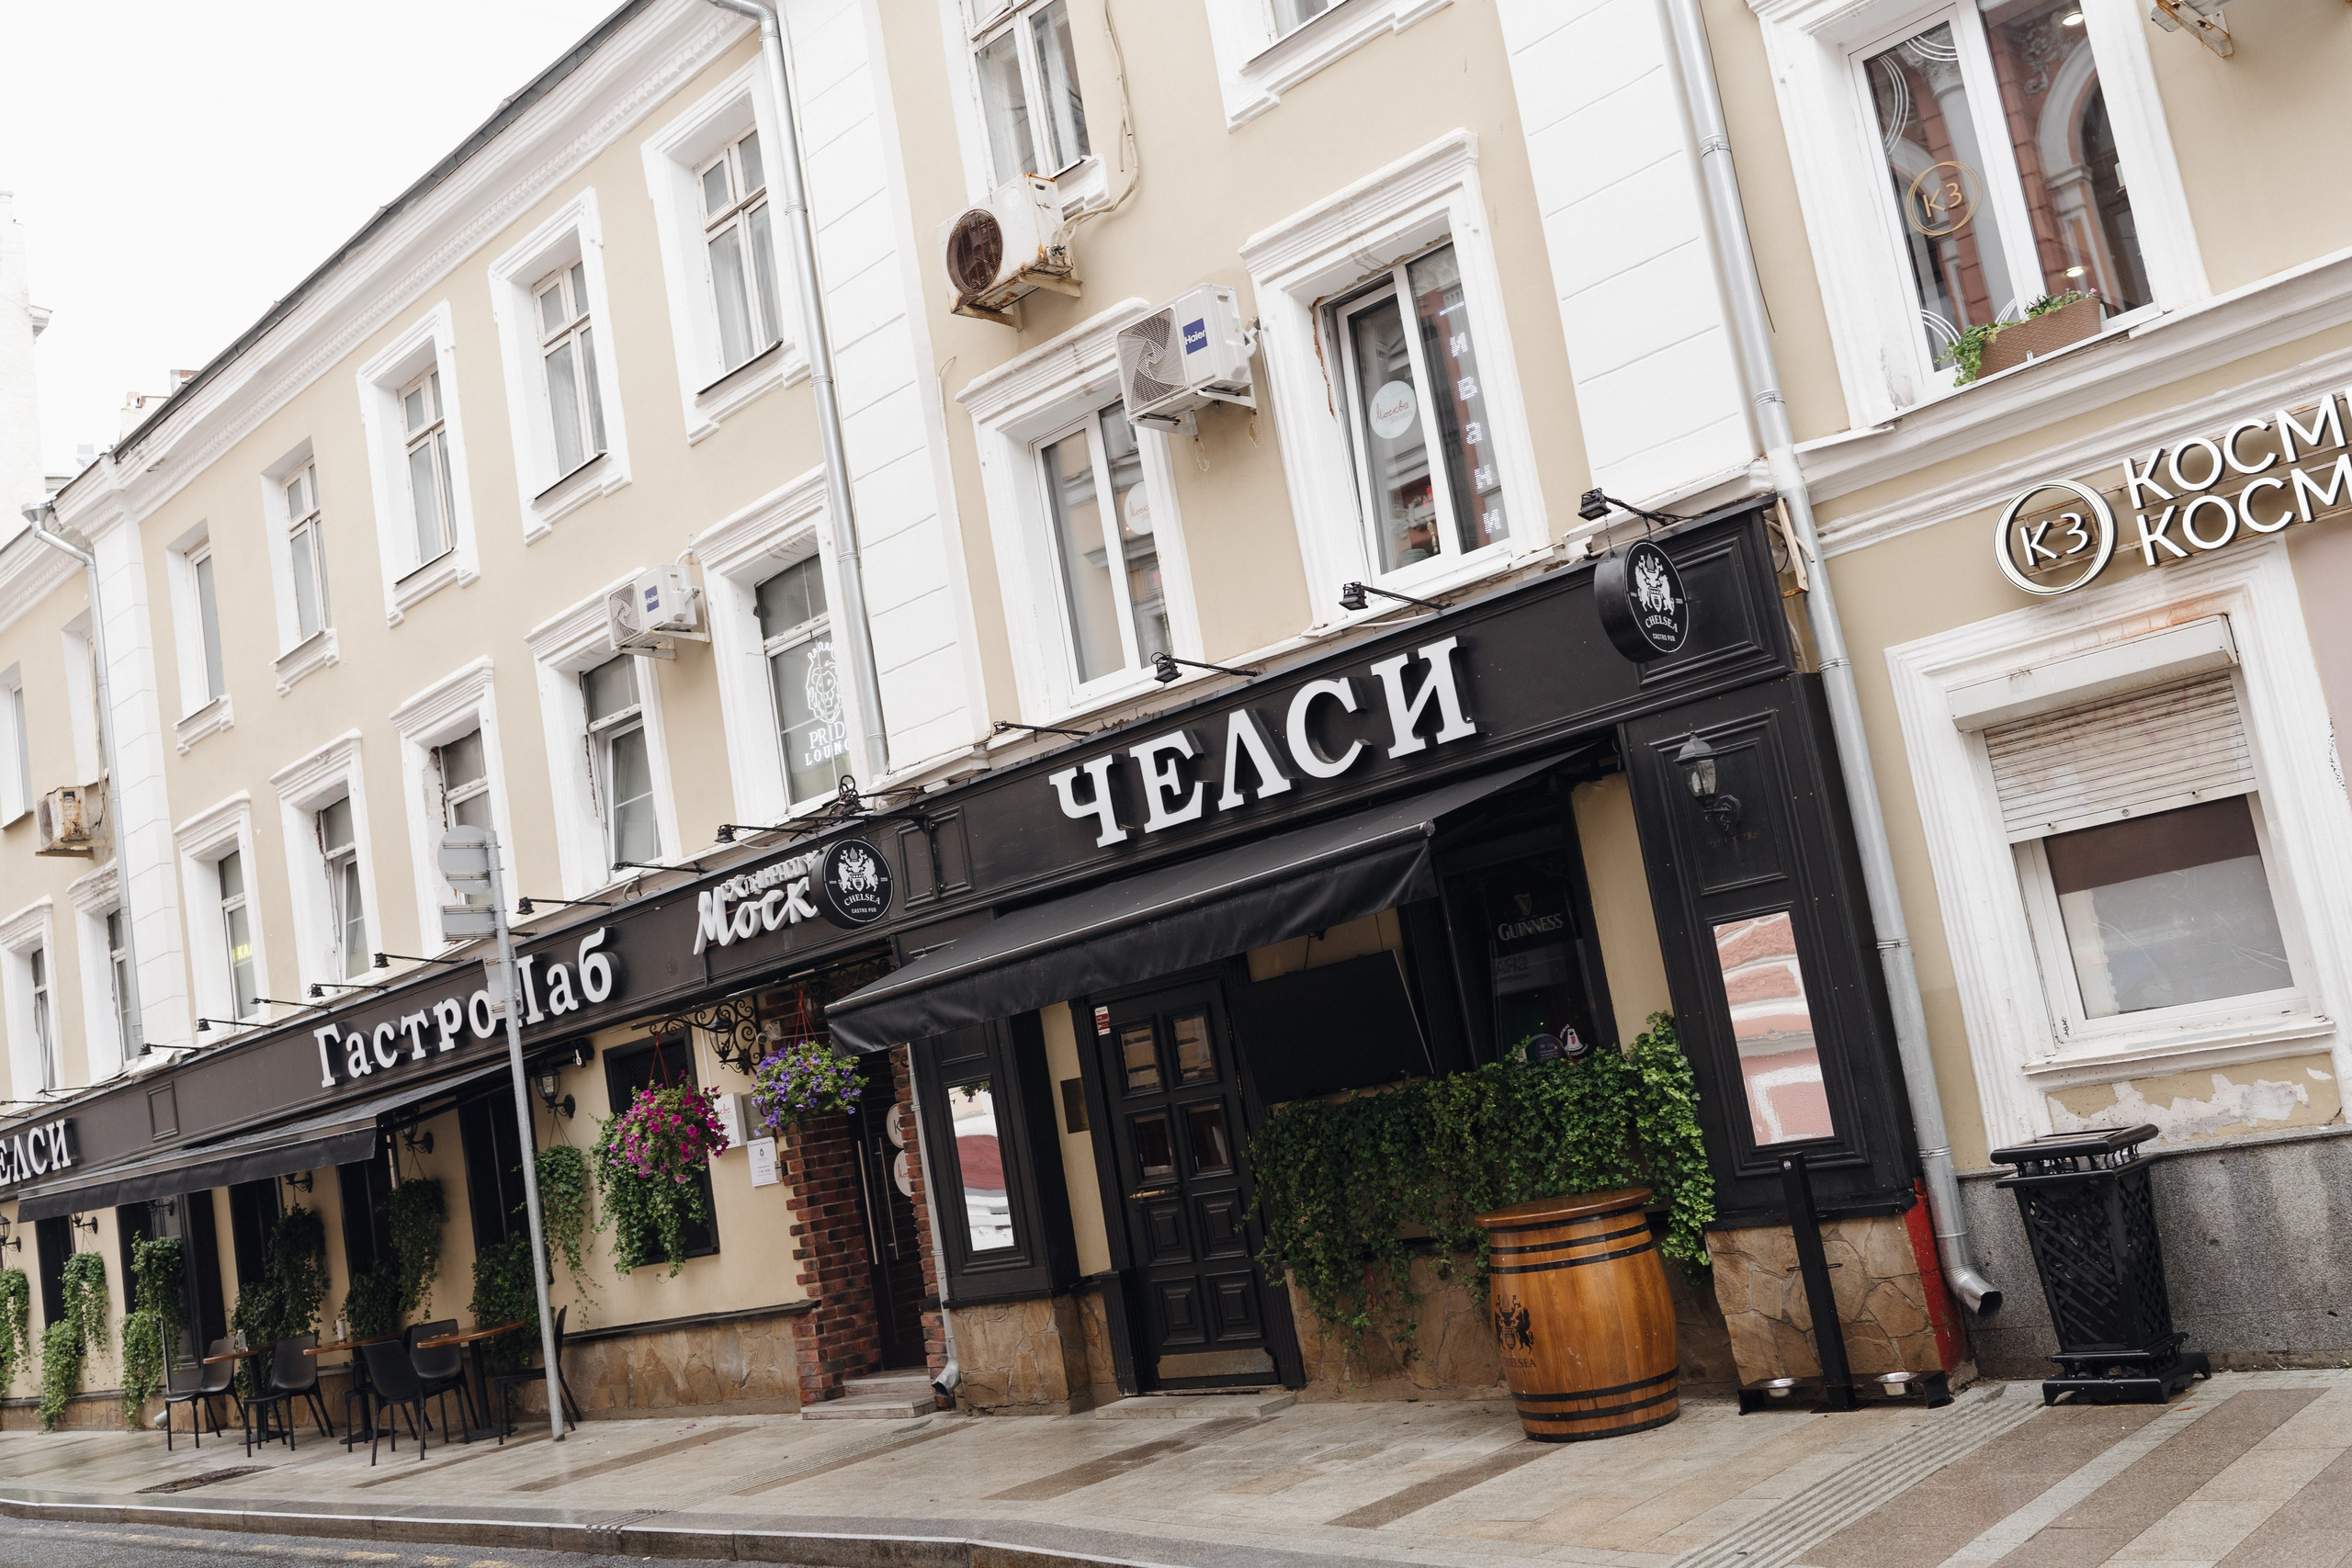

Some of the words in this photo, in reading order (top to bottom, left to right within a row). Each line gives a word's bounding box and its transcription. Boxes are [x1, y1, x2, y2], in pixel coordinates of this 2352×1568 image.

[1184, 330, 1205, 345] Haier
[1645, 615, 1679, 633] CHELSEA
[1048, 636, 1477, 848] ЧЕЛСИ
[843, 893, 881, 907] CHELSEA
[1498, 912, 1564, 942] GUINNESS
